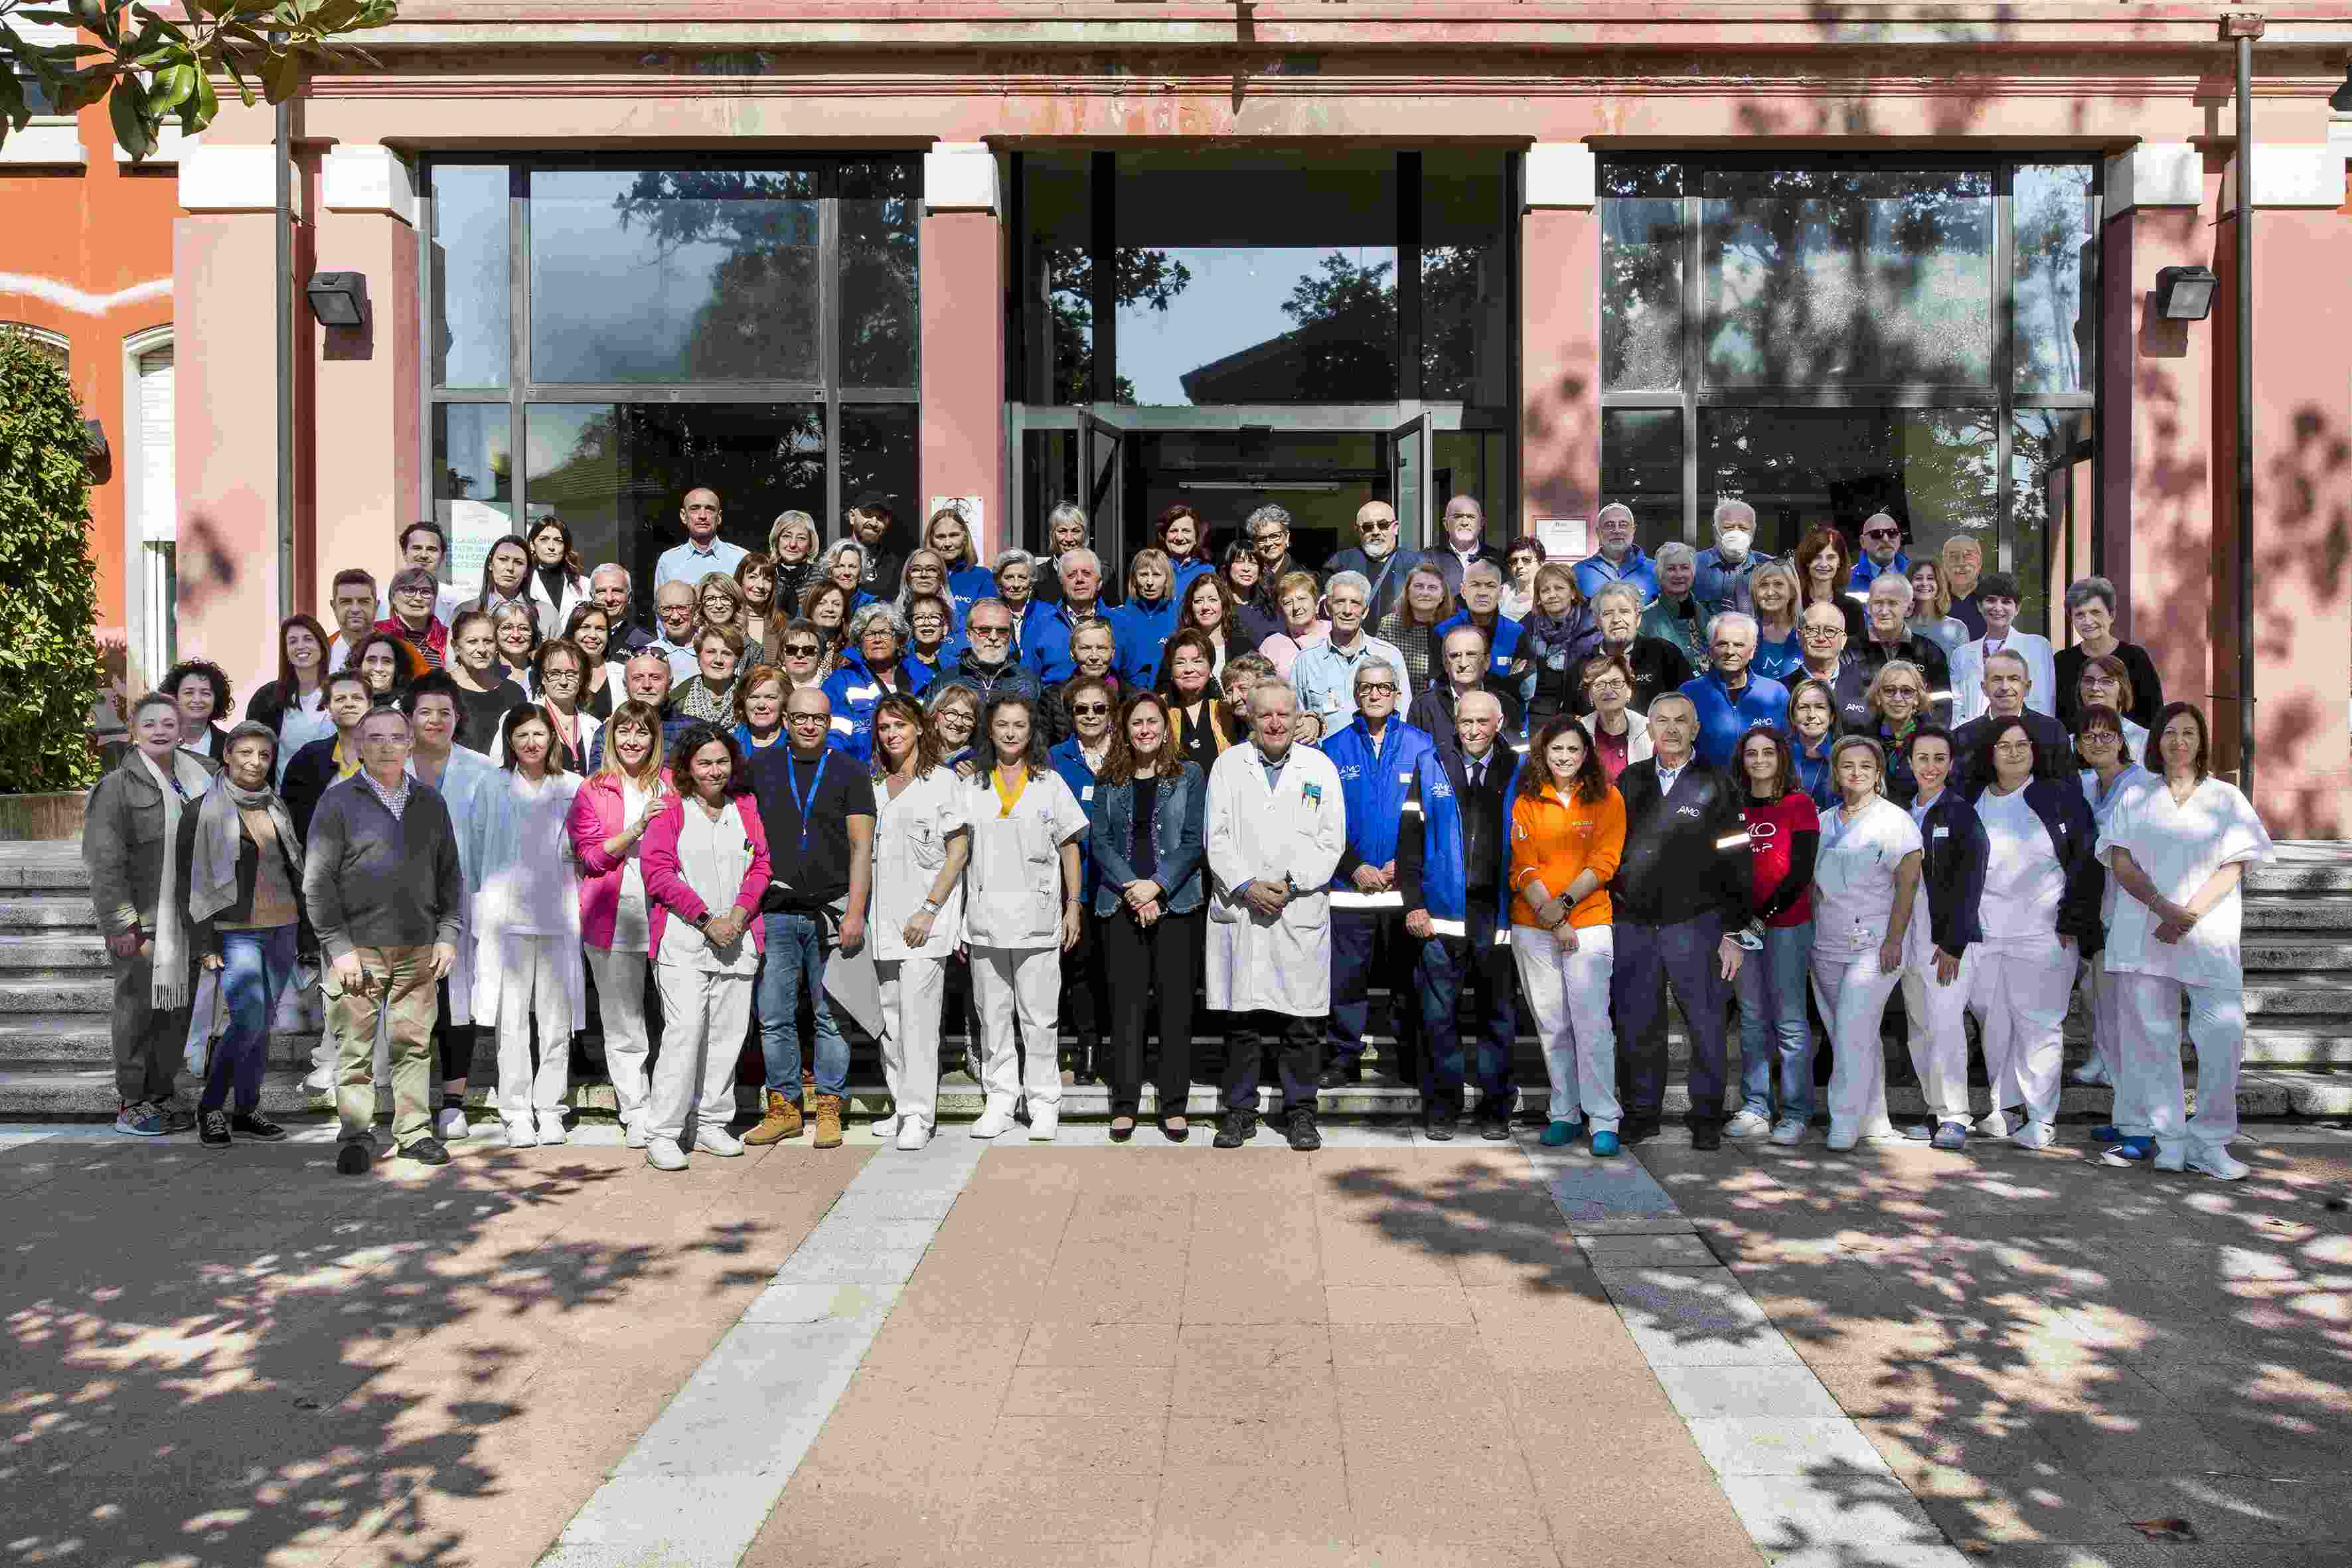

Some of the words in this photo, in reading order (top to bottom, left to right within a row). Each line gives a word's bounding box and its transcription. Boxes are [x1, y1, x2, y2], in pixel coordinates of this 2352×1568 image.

[1845, 703, 1864, 713] AMO
[1750, 718, 1773, 727] AMO
[1676, 805, 1700, 817] AMO
